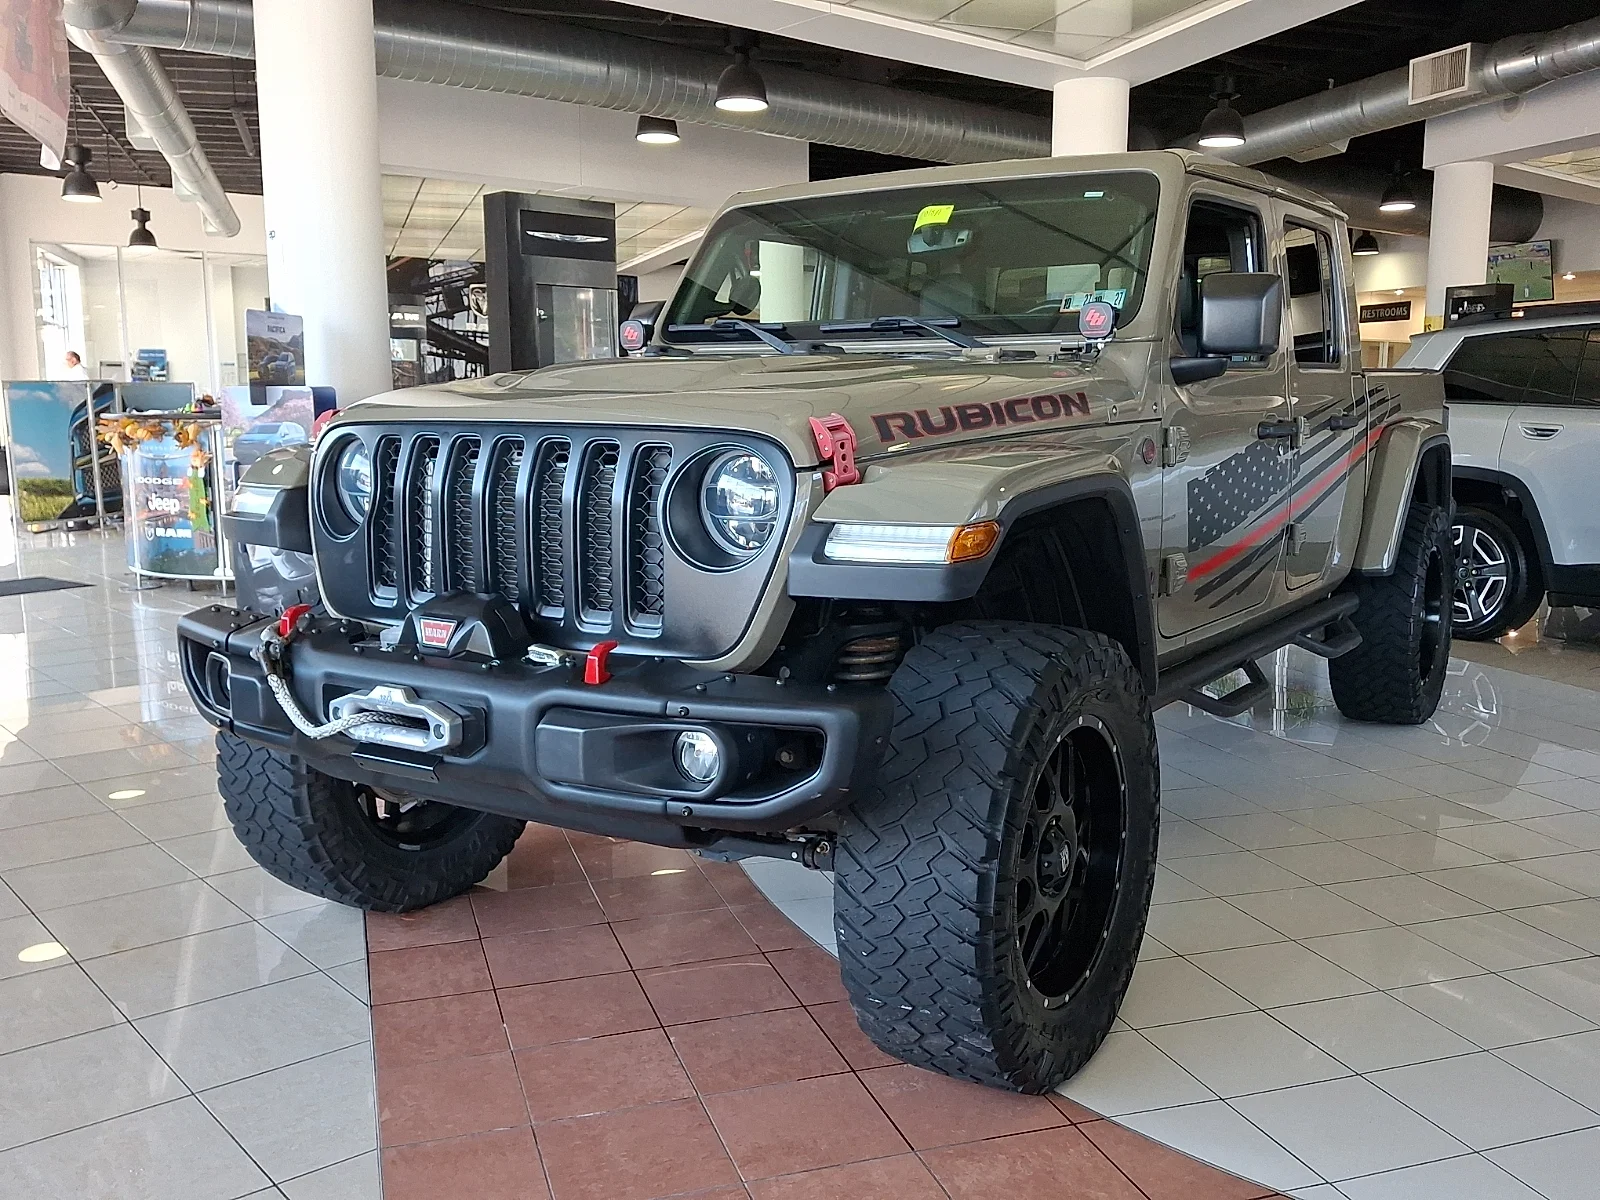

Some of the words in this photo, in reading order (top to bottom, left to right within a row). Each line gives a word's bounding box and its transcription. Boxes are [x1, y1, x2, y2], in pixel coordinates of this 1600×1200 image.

[1114, 291, 1124, 305] 27
[388, 312, 420, 321] AM
[1362, 306, 1408, 319] RESTROOMS
[871, 392, 1091, 442] RUBICON
[136, 476, 184, 486] DODGE
[148, 492, 180, 515] Jeep
[155, 527, 192, 538] RAM
[425, 627, 447, 638] WARN
